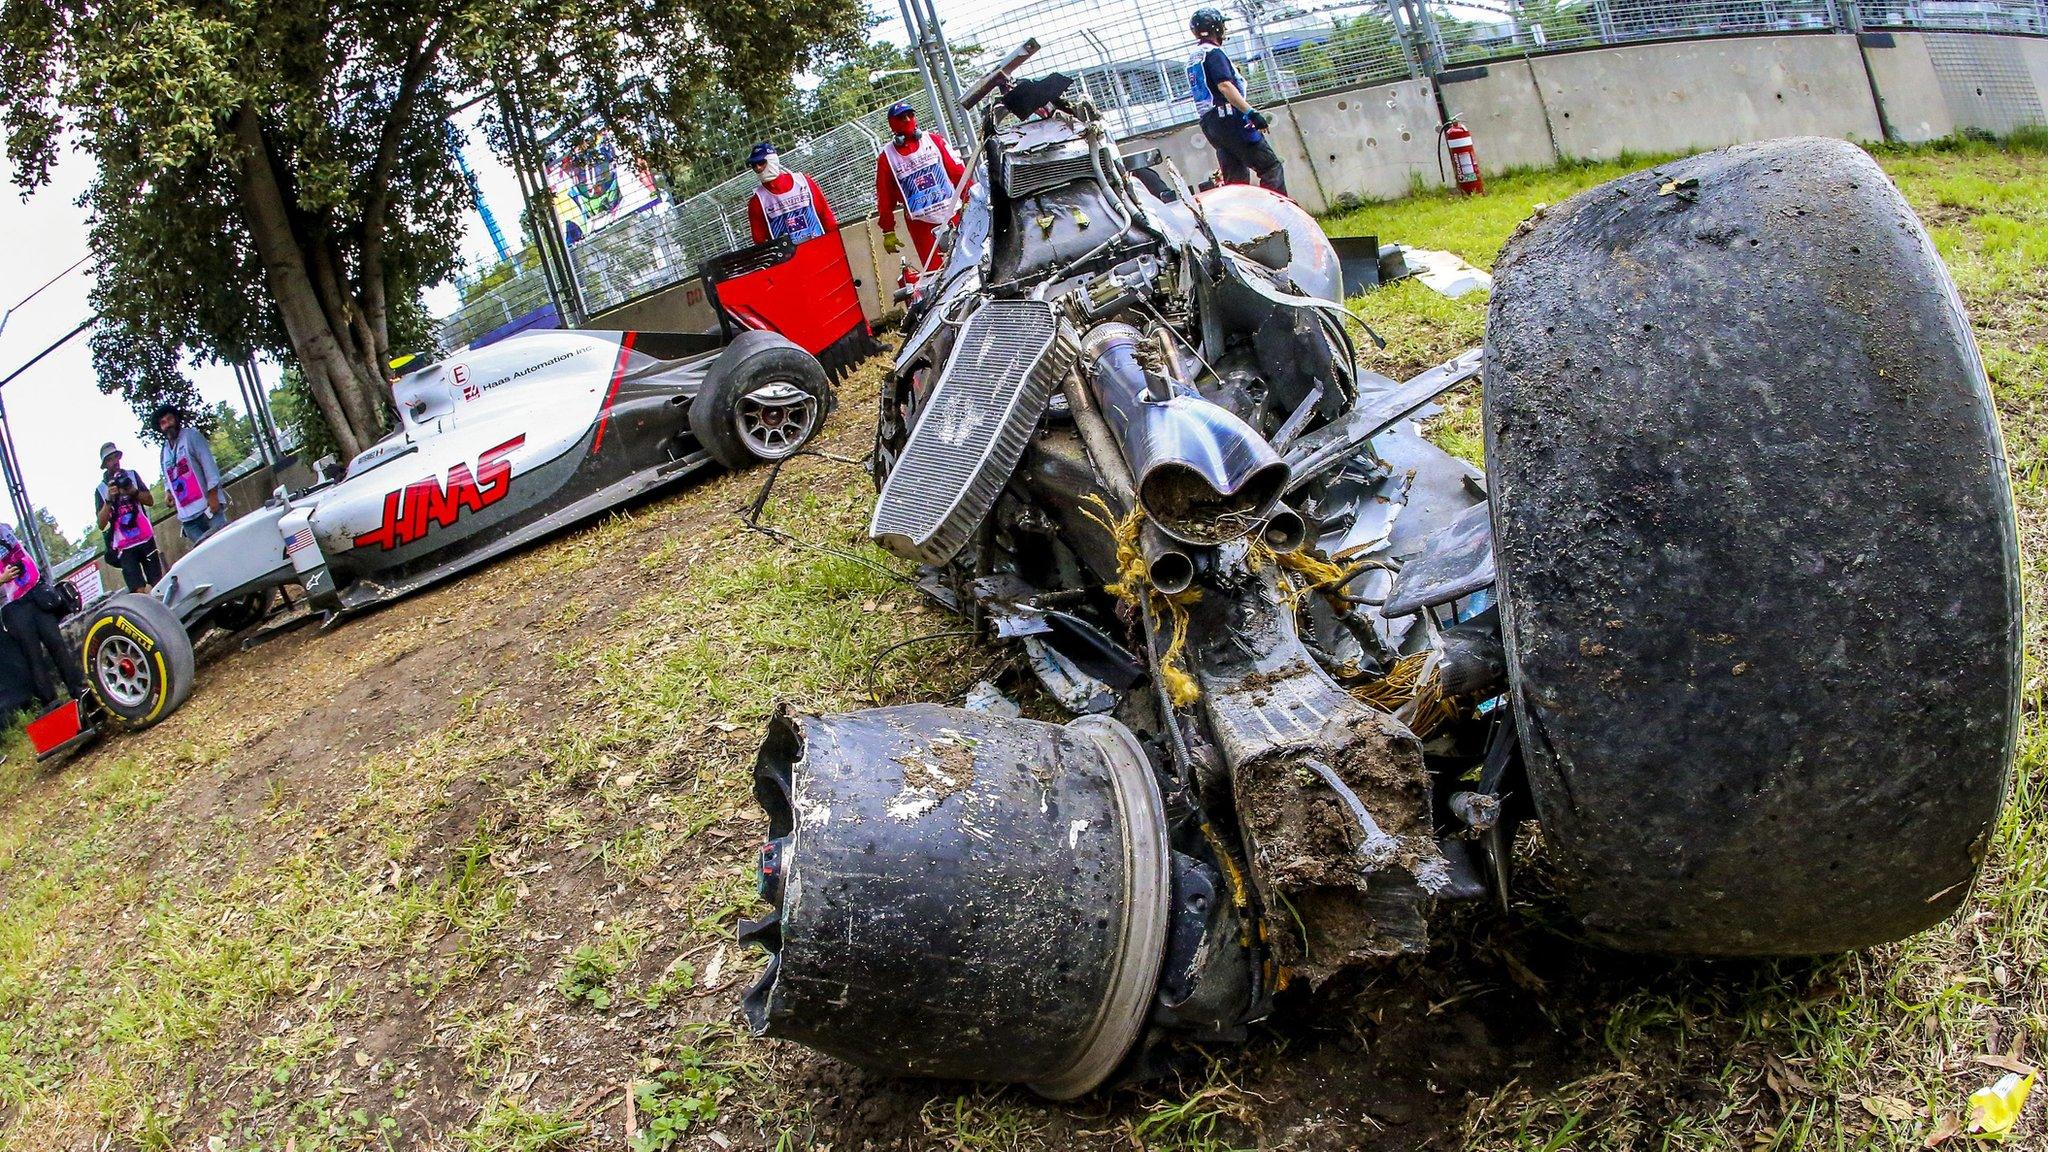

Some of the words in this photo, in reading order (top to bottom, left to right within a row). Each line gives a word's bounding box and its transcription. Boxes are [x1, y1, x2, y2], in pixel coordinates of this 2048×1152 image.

[453, 365, 466, 384] E
[483, 376, 510, 391] Haas
[513, 351, 574, 379] Automation
[352, 432, 527, 550] HAAS
[115, 615, 154, 651] PIRELLI
